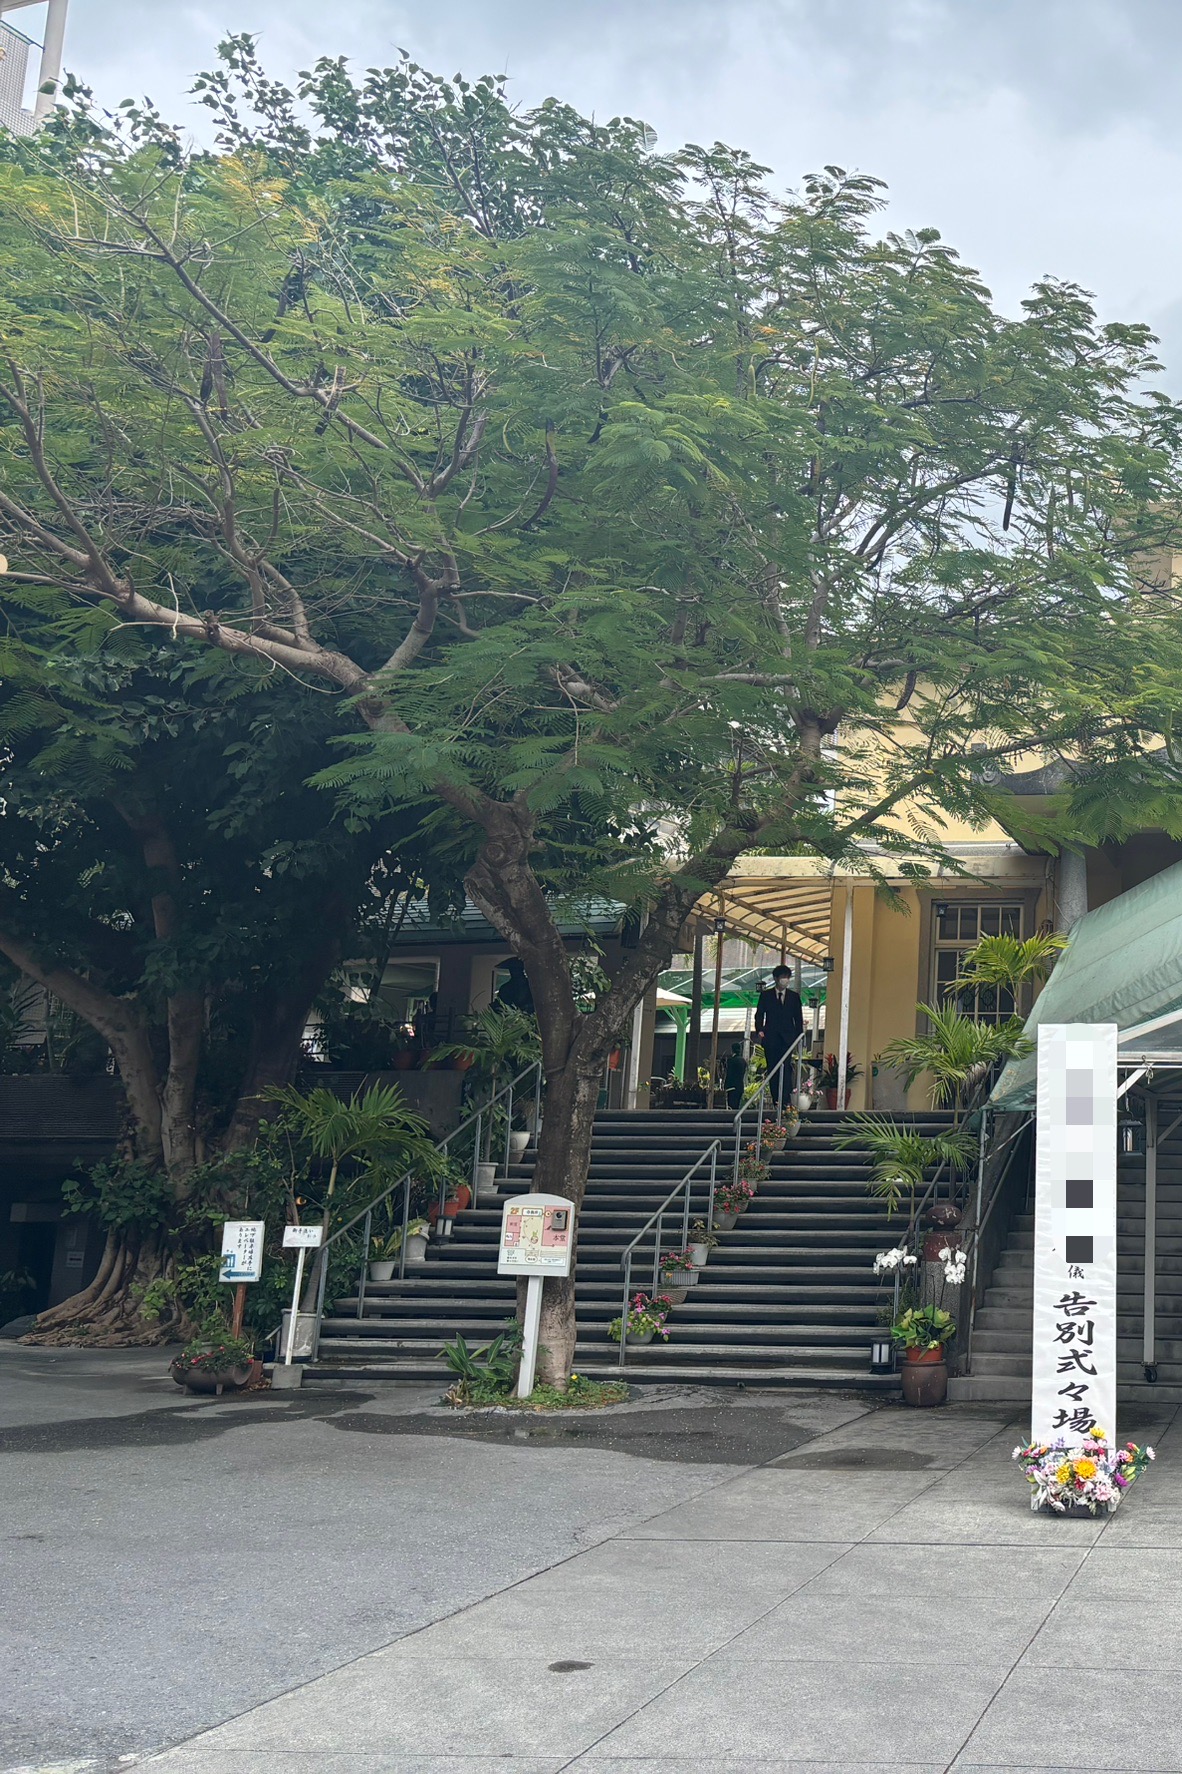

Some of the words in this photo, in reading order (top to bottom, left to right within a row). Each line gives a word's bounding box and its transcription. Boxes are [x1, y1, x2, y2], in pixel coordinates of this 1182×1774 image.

[1067, 1264, 1085, 1280] 儀
[1052, 1291, 1098, 1434] 告別式々場
